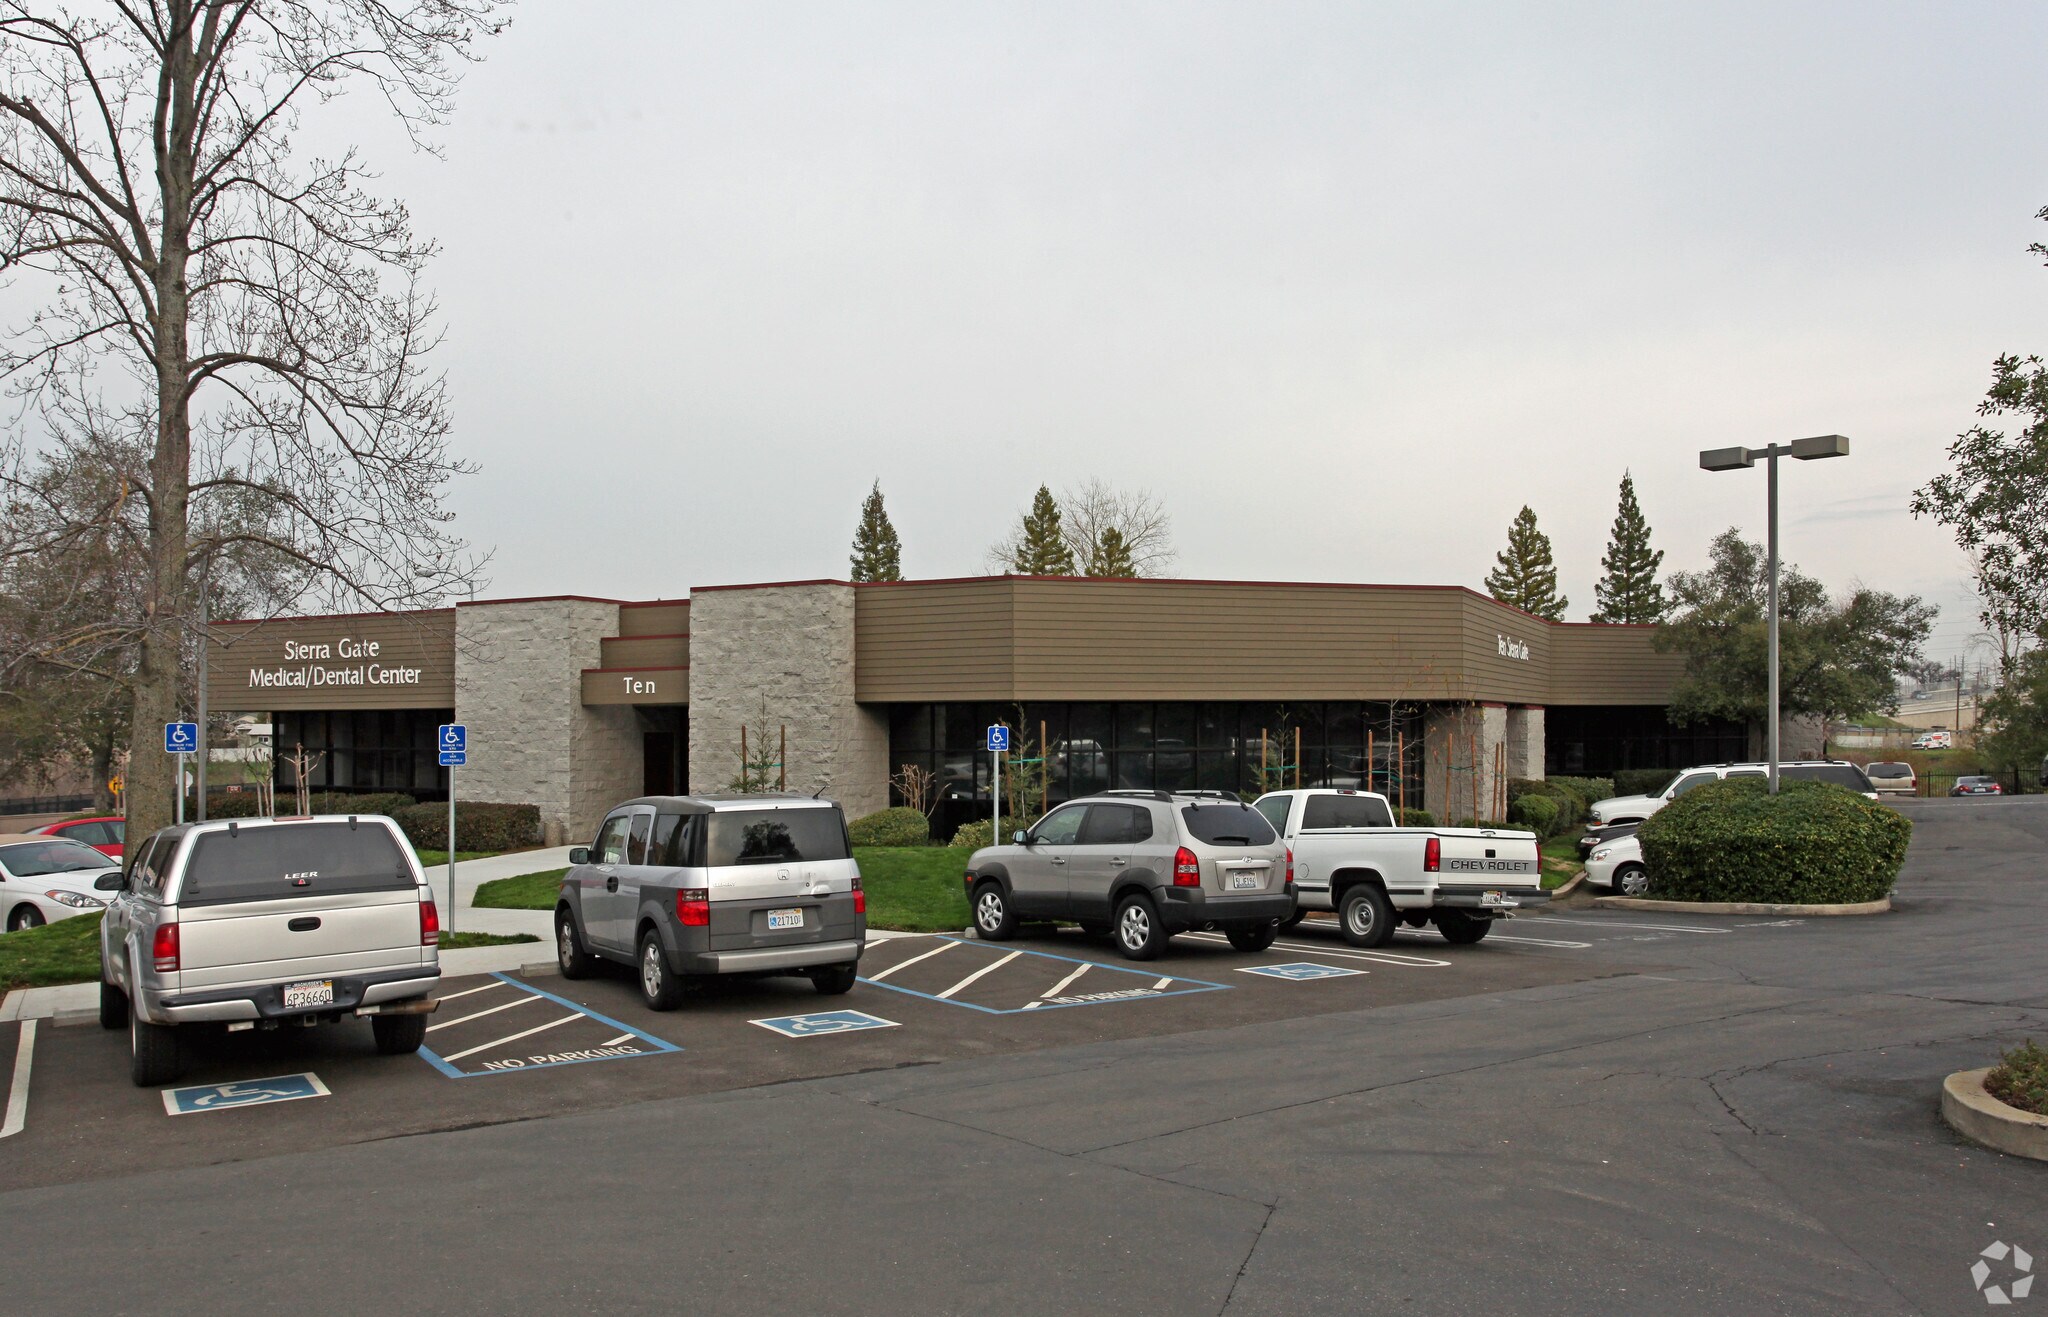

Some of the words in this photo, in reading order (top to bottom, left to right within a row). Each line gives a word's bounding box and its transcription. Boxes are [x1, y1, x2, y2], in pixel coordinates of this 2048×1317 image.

[284, 640, 331, 660] Sierra
[338, 638, 380, 659] Gate
[249, 664, 364, 688] Medical/Dental
[367, 663, 422, 685] Center
[623, 677, 656, 694] Ten
[1450, 860, 1529, 871] CHEVROLET
[284, 871, 318, 880] LEER
[482, 1058, 526, 1071] NO
[527, 1045, 643, 1065] PARKING
